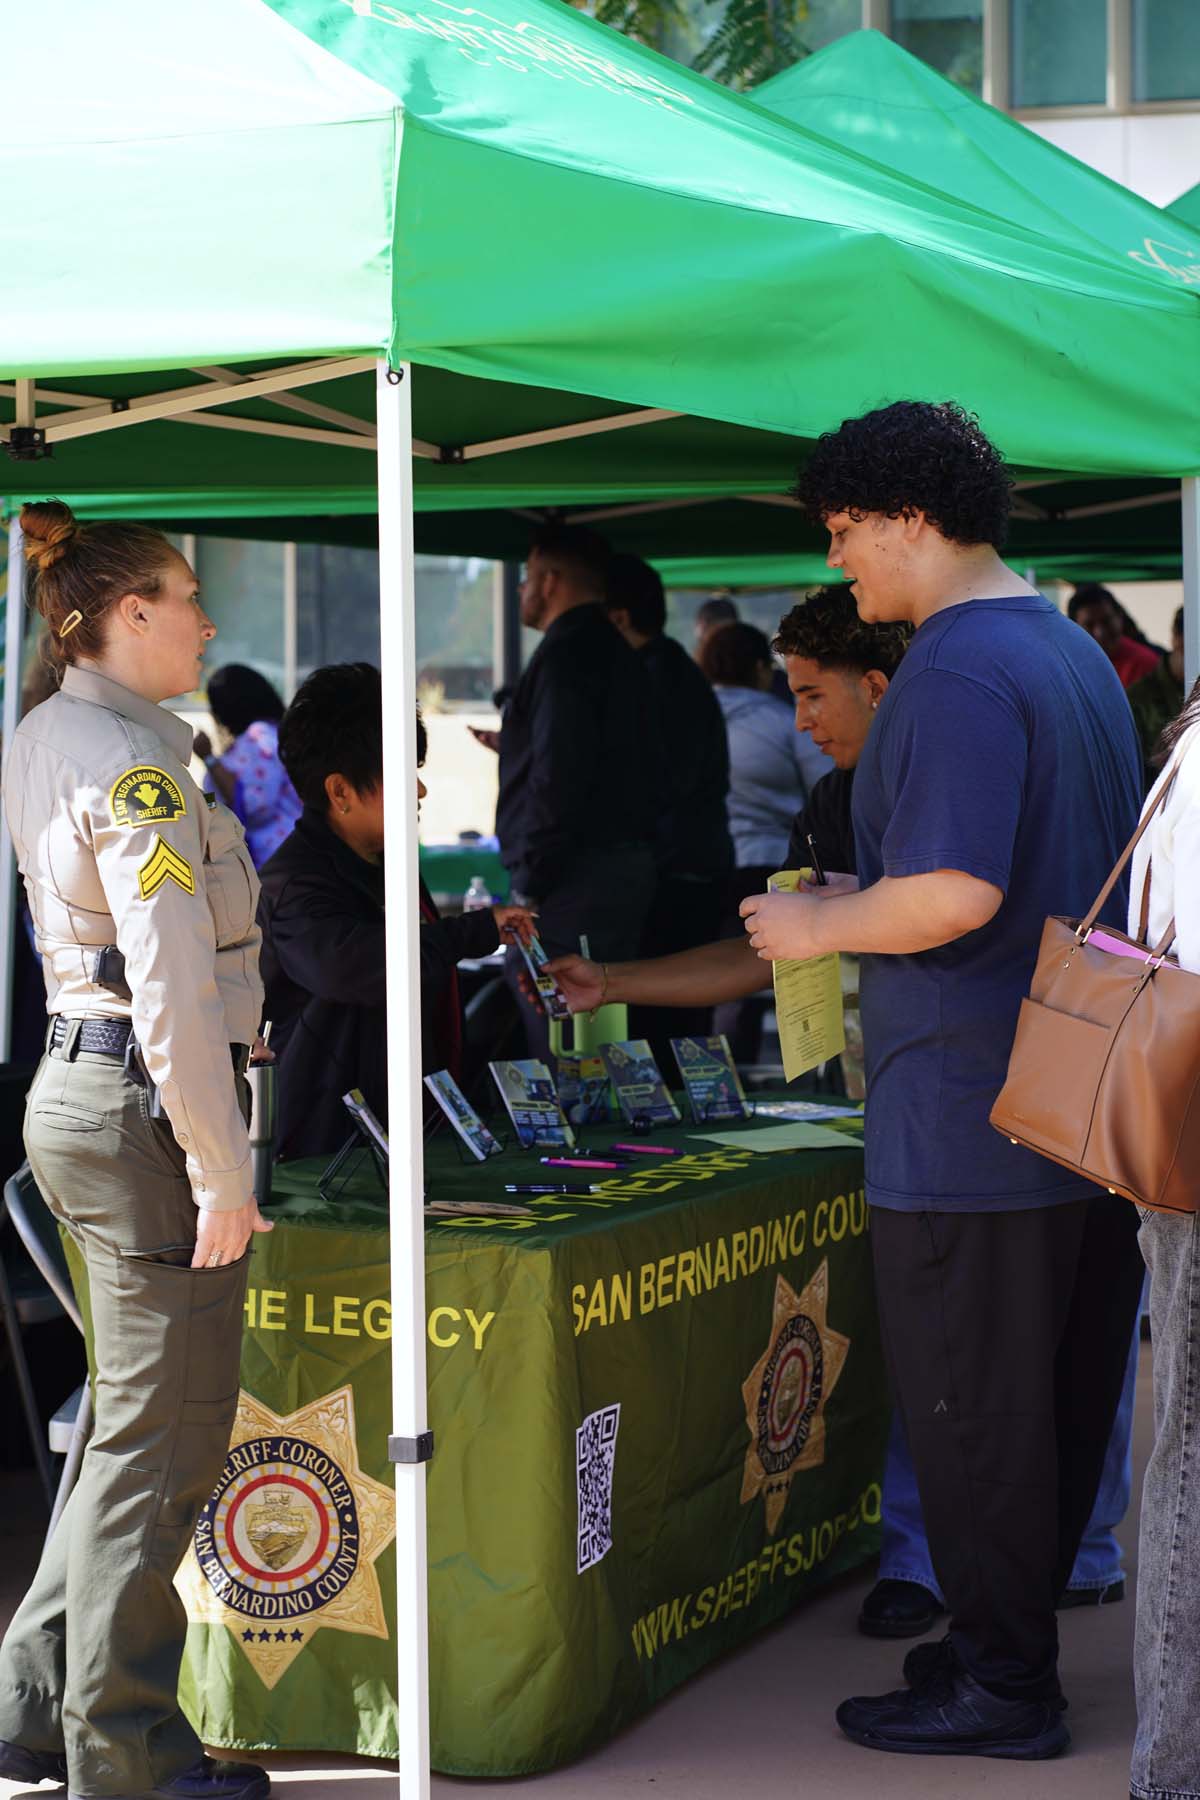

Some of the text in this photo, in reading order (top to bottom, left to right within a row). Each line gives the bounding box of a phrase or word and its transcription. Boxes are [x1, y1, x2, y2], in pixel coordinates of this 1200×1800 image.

[116, 773, 181, 816] SAN BERNARDINO COUNTY
[136, 806, 168, 820] SHERIFF
[572, 1188, 872, 1336] SAN BERNARDINO COU
[243, 1287, 496, 1350] HE LEGCY
[194, 1518, 359, 1618] SAN BERNARDINO COUNTY
